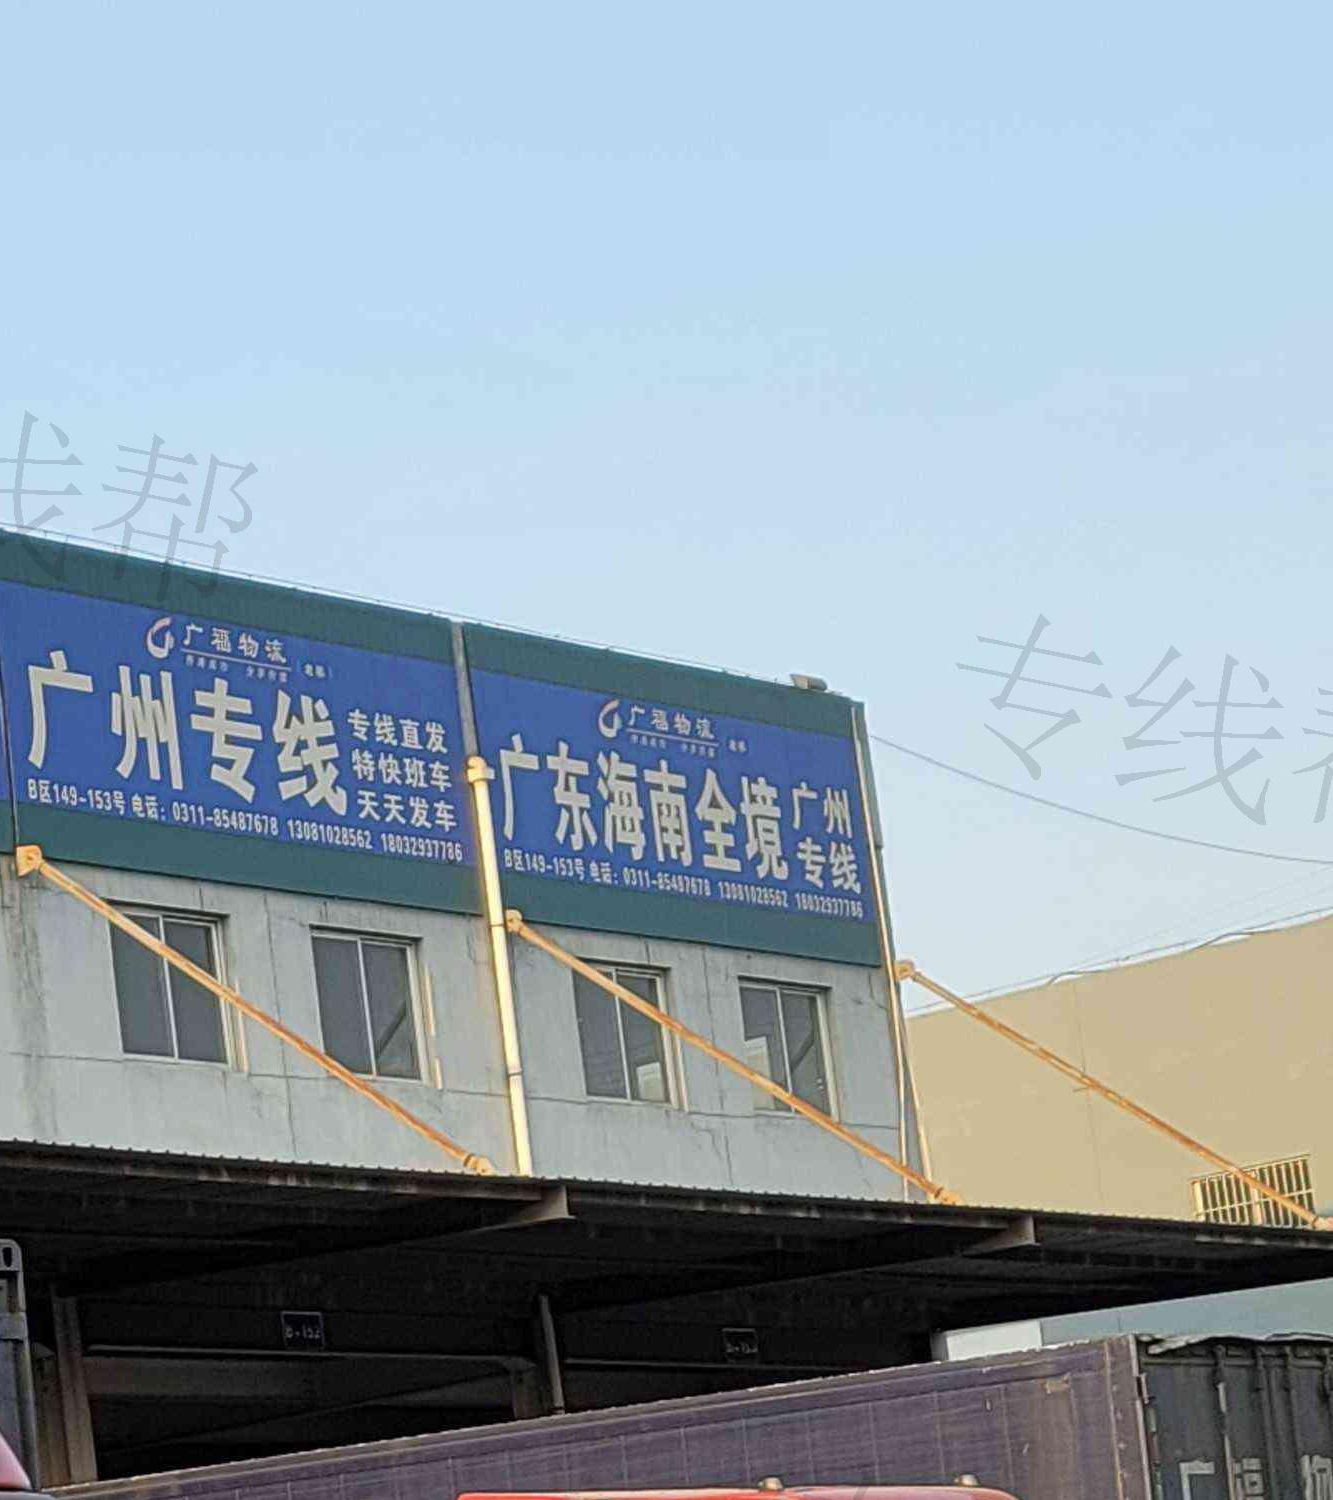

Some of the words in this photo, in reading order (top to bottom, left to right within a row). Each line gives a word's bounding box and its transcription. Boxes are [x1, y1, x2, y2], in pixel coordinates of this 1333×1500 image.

[27, 650, 347, 816] 广州专线
[347, 708, 448, 754] 专线直发
[351, 748, 452, 793] 特快班车
[172, 801, 278, 836] 0311-85487678
[357, 789, 457, 833] 天天发车
[499, 733, 789, 881] 广东海南全境
[792, 782, 853, 838] 广州
[797, 836, 862, 894] 专线
